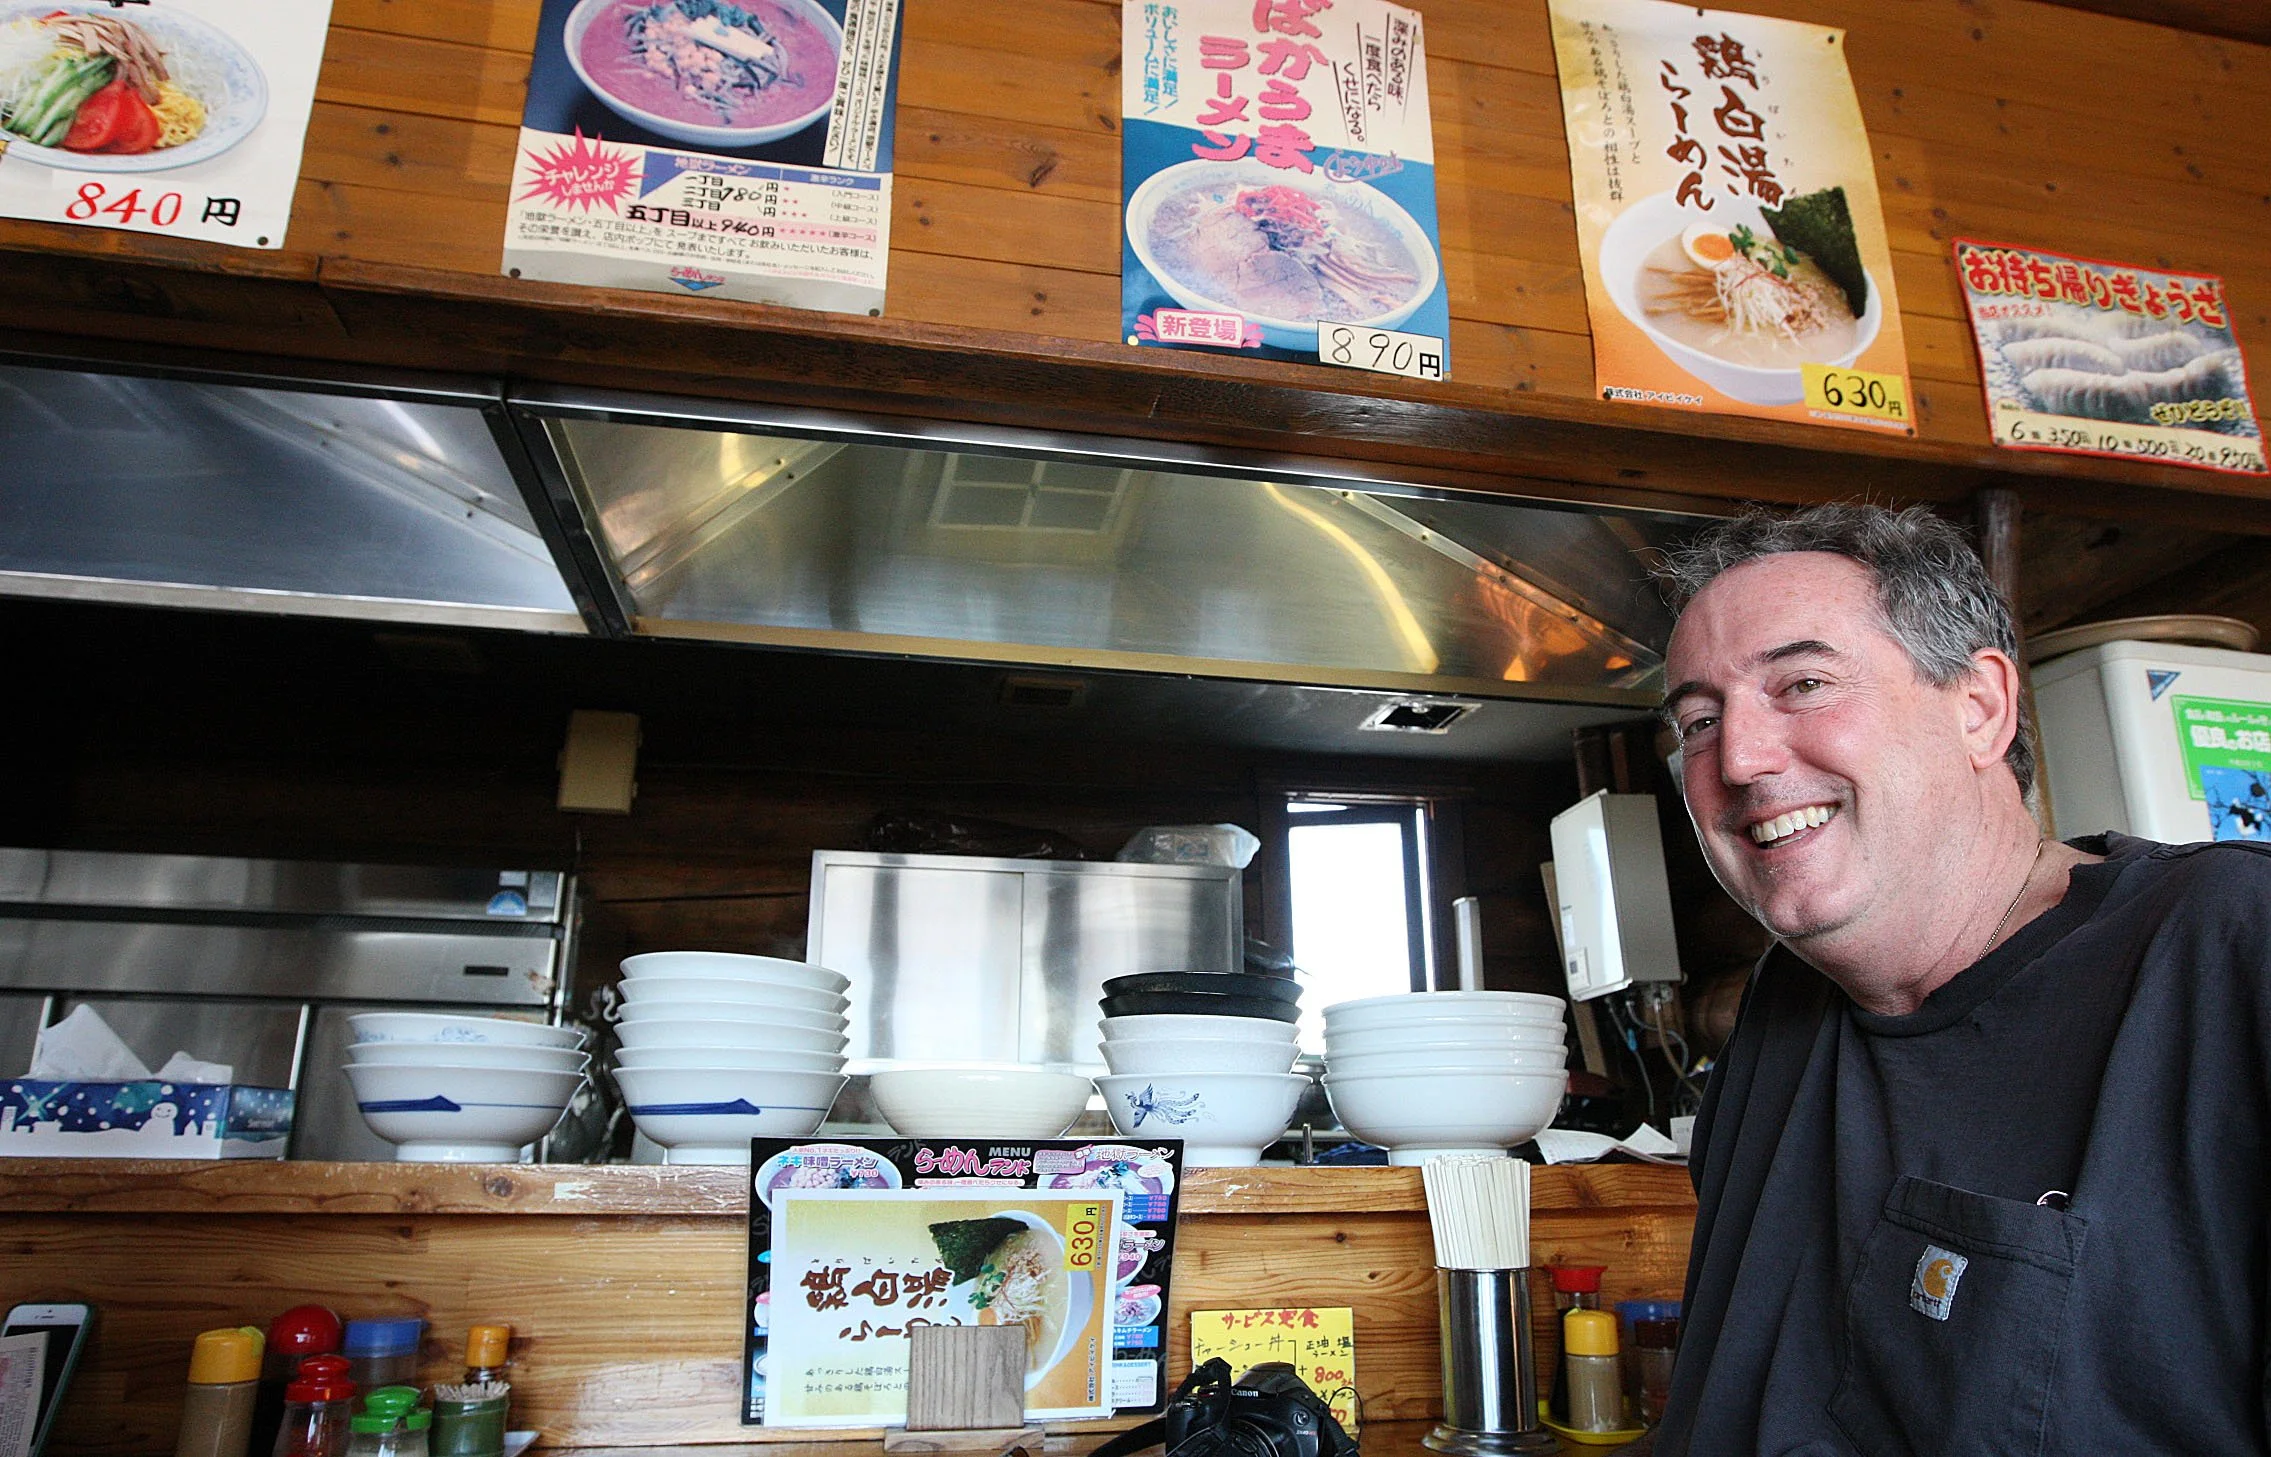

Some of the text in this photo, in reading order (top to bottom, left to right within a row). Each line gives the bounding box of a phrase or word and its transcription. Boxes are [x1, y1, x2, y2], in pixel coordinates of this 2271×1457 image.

[1192, 36, 1251, 161] ラーメン
[1342, 62, 1365, 143] くせになる。
[1691, 32, 1785, 208] 鶏白湯
[1660, 60, 1715, 211] らーめん
[544, 162, 620, 186] チャレンジ
[561, 180, 616, 197] しませんか
[65, 182, 241, 227] 840円
[1964, 249, 2227, 327] お持ち帰りぎょうざ
[1161, 313, 1238, 341] 新登場
[1331, 326, 1440, 378] 890円
[1823, 372, 1903, 416] 630円
[989, 1146, 1032, 1158] MENU
[1071, 1206, 1097, 1267] 630円
[1119, 1237, 1166, 1253] ラーメン
[800, 1266, 956, 1314] 鶏白湯
[1222, 1309, 1319, 1330] サービス定食
[1231, 1387, 1259, 1397] Canon
